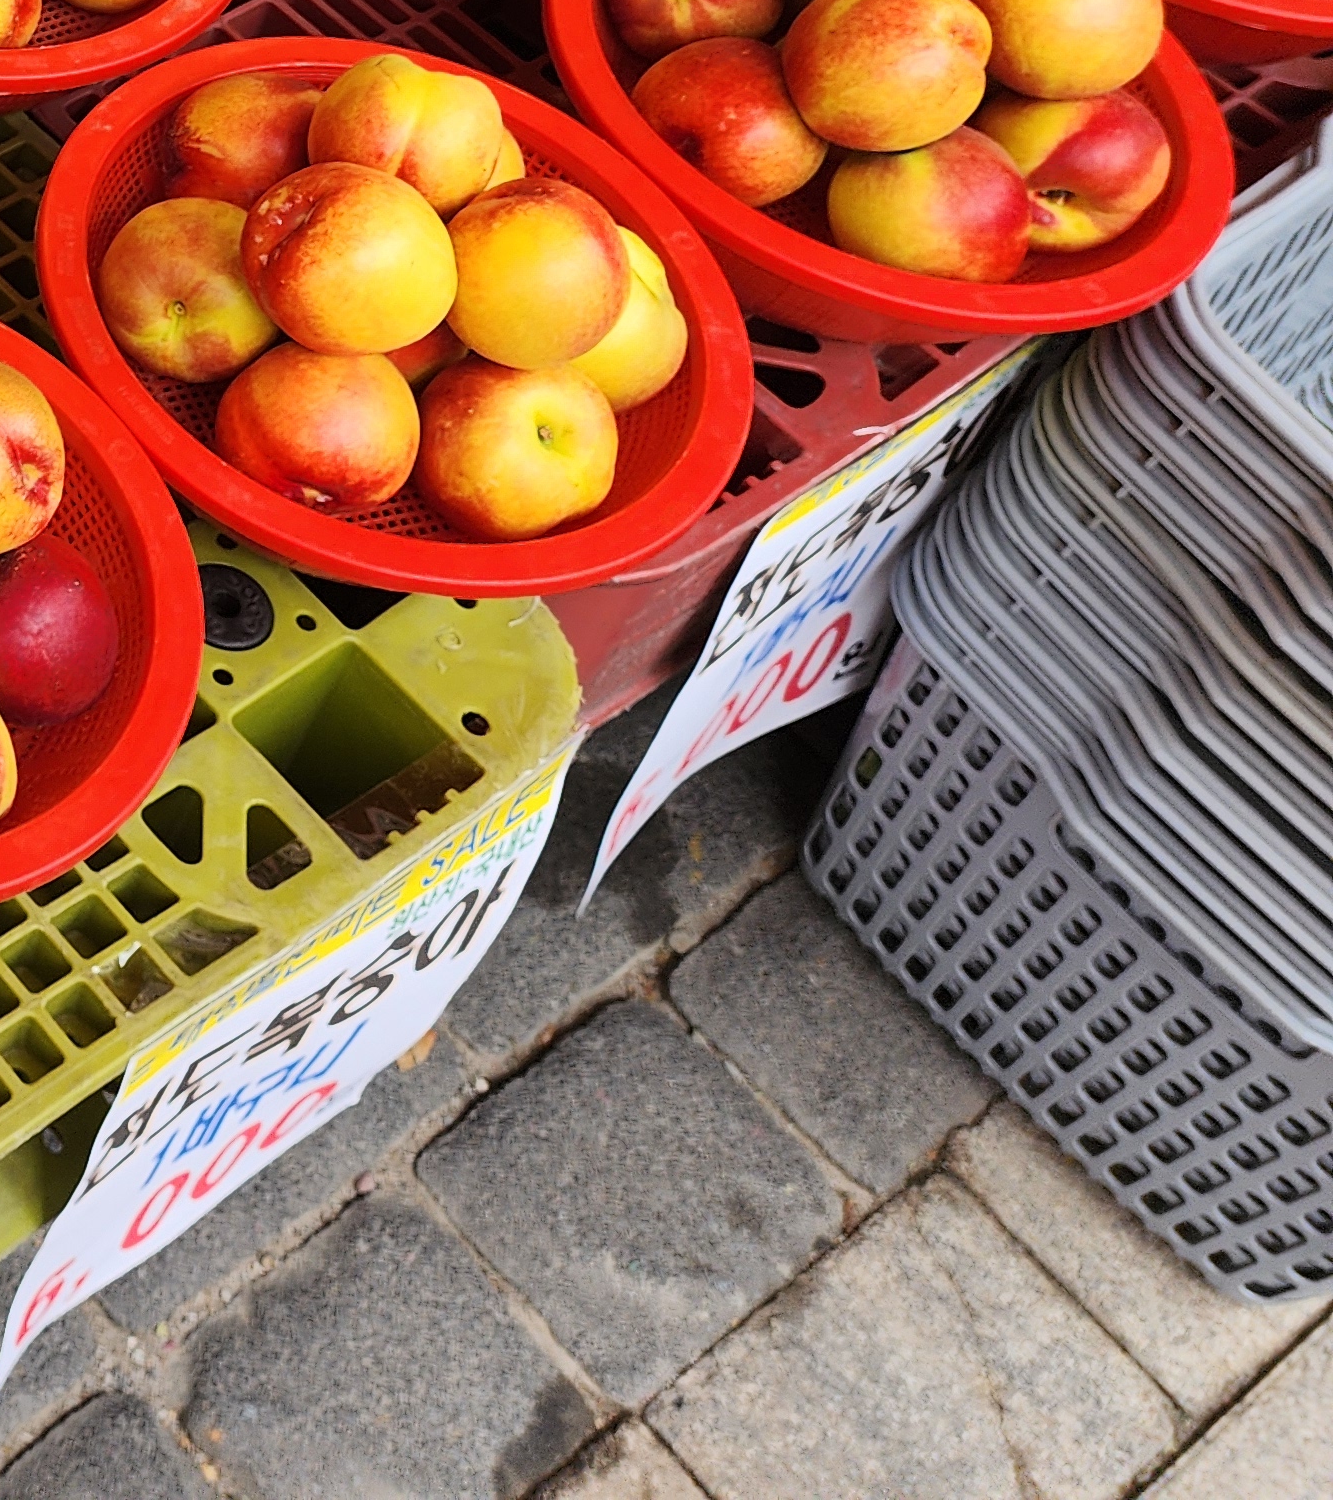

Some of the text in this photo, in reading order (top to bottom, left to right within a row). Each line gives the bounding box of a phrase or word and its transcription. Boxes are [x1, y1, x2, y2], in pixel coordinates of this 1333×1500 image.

[422, 777, 542, 887] SALE
[77, 858, 520, 1204] 천도복숭아
[142, 1018, 370, 1190] 1바구니
